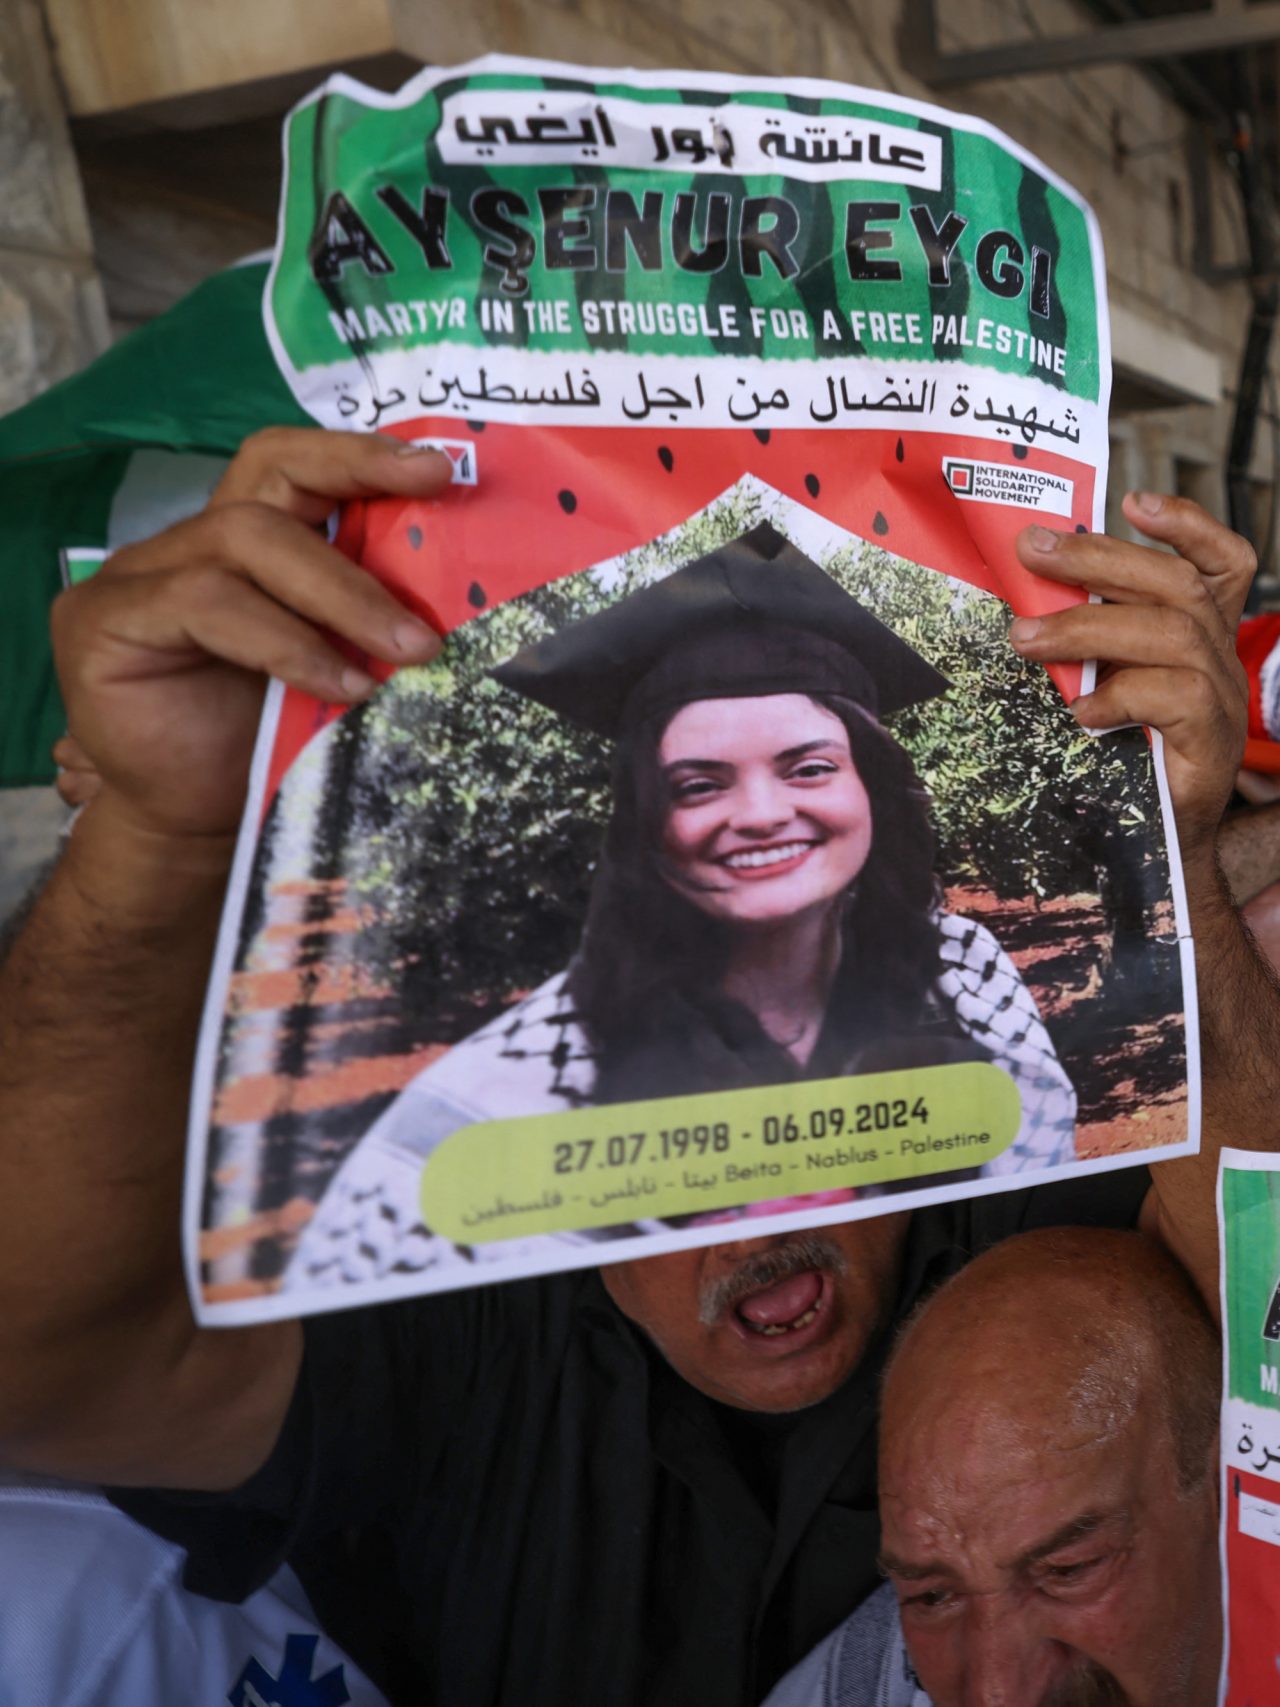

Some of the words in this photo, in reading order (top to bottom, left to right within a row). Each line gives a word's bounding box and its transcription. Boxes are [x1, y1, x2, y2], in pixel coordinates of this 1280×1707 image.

[651, 117, 735, 169] نور
[310, 184, 801, 297] AYŞENUR
[844, 200, 1052, 319] EYGI
[329, 298, 466, 343] MARTYR
[481, 299, 515, 333] IN
[523, 301, 573, 334] THE
[582, 302, 740, 337] STRUGGLE
[751, 307, 809, 340] FOR
[823, 309, 841, 341] A
[851, 312, 924, 344] FREE
[931, 314, 1068, 376] PALESTINE
[336, 382, 406, 427] حرة
[418, 366, 601, 412] فلسطين
[622, 372, 705, 421] اجل
[728, 376, 789, 421] من
[810, 376, 937, 422] النضال
[950, 382, 1080, 444] شهيدة
[974, 488, 1041, 505] MOVEMENT
[975, 477, 1045, 495] SOLIDARITY
[976, 465, 1068, 493] INTERNATIONAL
[554, 1122, 730, 1175] 27.07.1998
[763, 1097, 929, 1146] 06.09.2024
[725, 1163, 782, 1183] Beita
[806, 1145, 878, 1171] Nablus
[901, 1131, 991, 1156] Palestine
